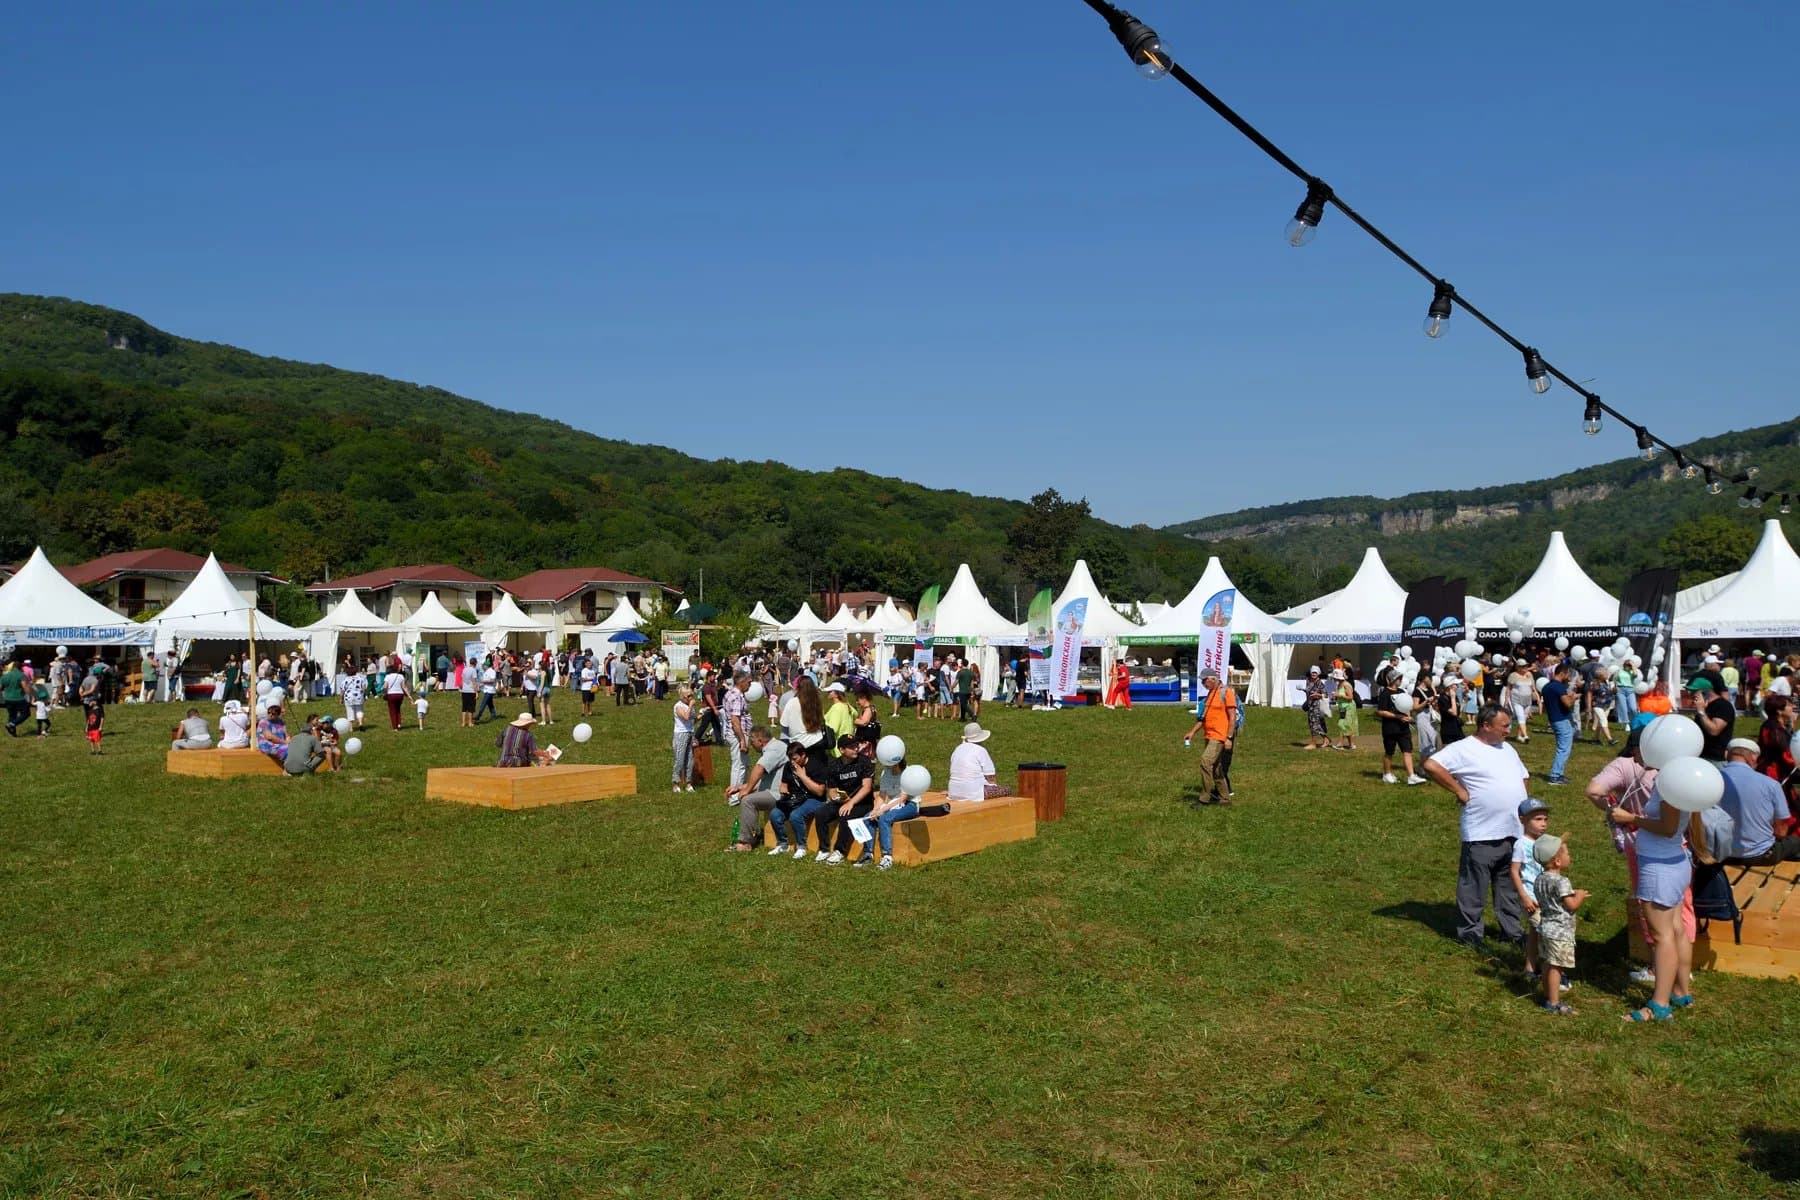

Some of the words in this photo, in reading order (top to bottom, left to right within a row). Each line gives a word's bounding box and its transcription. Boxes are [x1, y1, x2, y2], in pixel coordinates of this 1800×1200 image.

[27, 627, 95, 640] ДОНДУКОВСКИЕ
[98, 628, 125, 640] СЫРЫ
[1285, 634, 1304, 642] БЕЛОЕ
[1305, 634, 1331, 642] ЗОЛОТО
[1332, 634, 1348, 642] ООО
[1478, 631, 1498, 640] ОАО
[1549, 629, 1617, 640] «ГИАГИНСКИЙ»
[1057, 634, 1071, 692] Майкопская
[1204, 648, 1213, 669] СЫР
